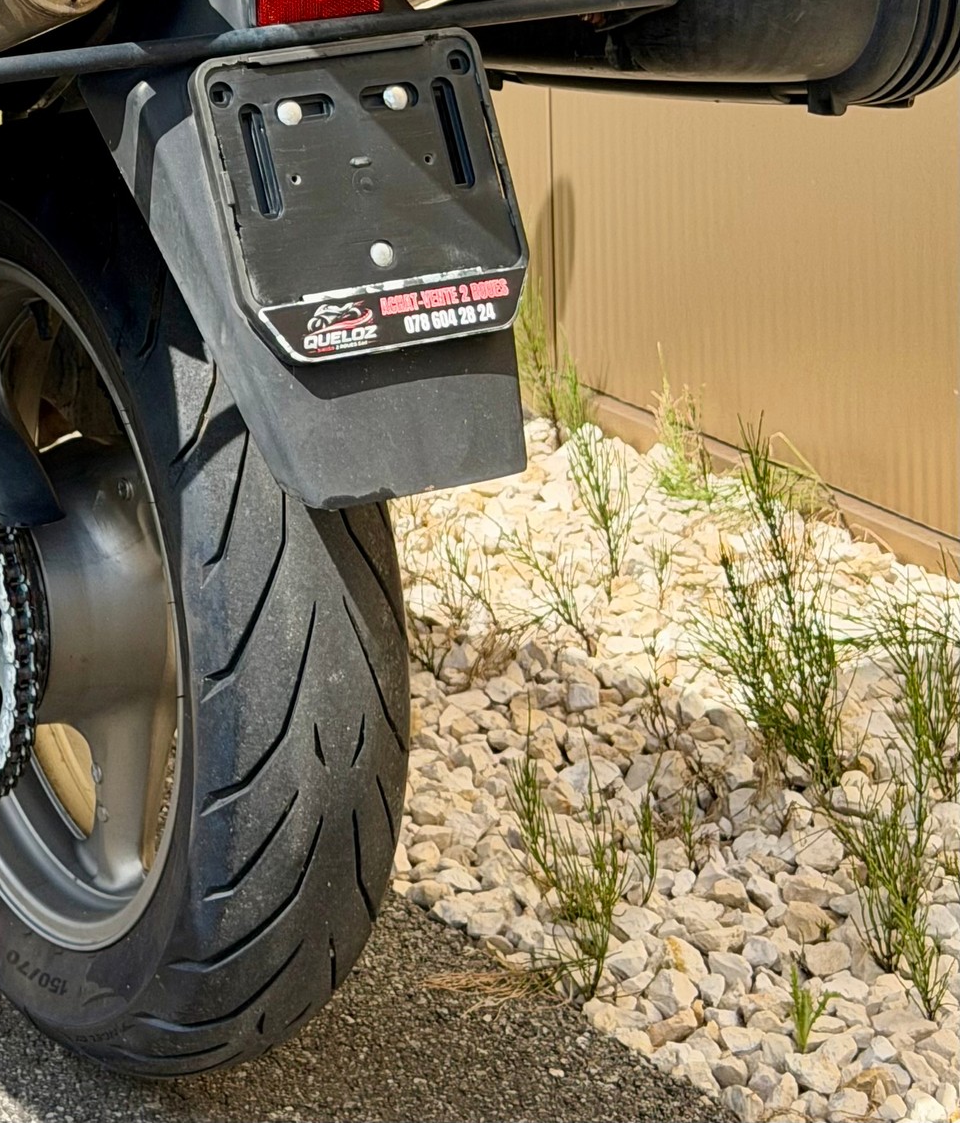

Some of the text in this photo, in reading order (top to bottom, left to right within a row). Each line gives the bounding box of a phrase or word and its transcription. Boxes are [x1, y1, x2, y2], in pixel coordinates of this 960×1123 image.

[459, 283, 471, 303] 2
[403, 302, 497, 334] 078 604 28 24
[303, 324, 378, 351] QUELOZ
[6, 949, 68, 996] 150/70
